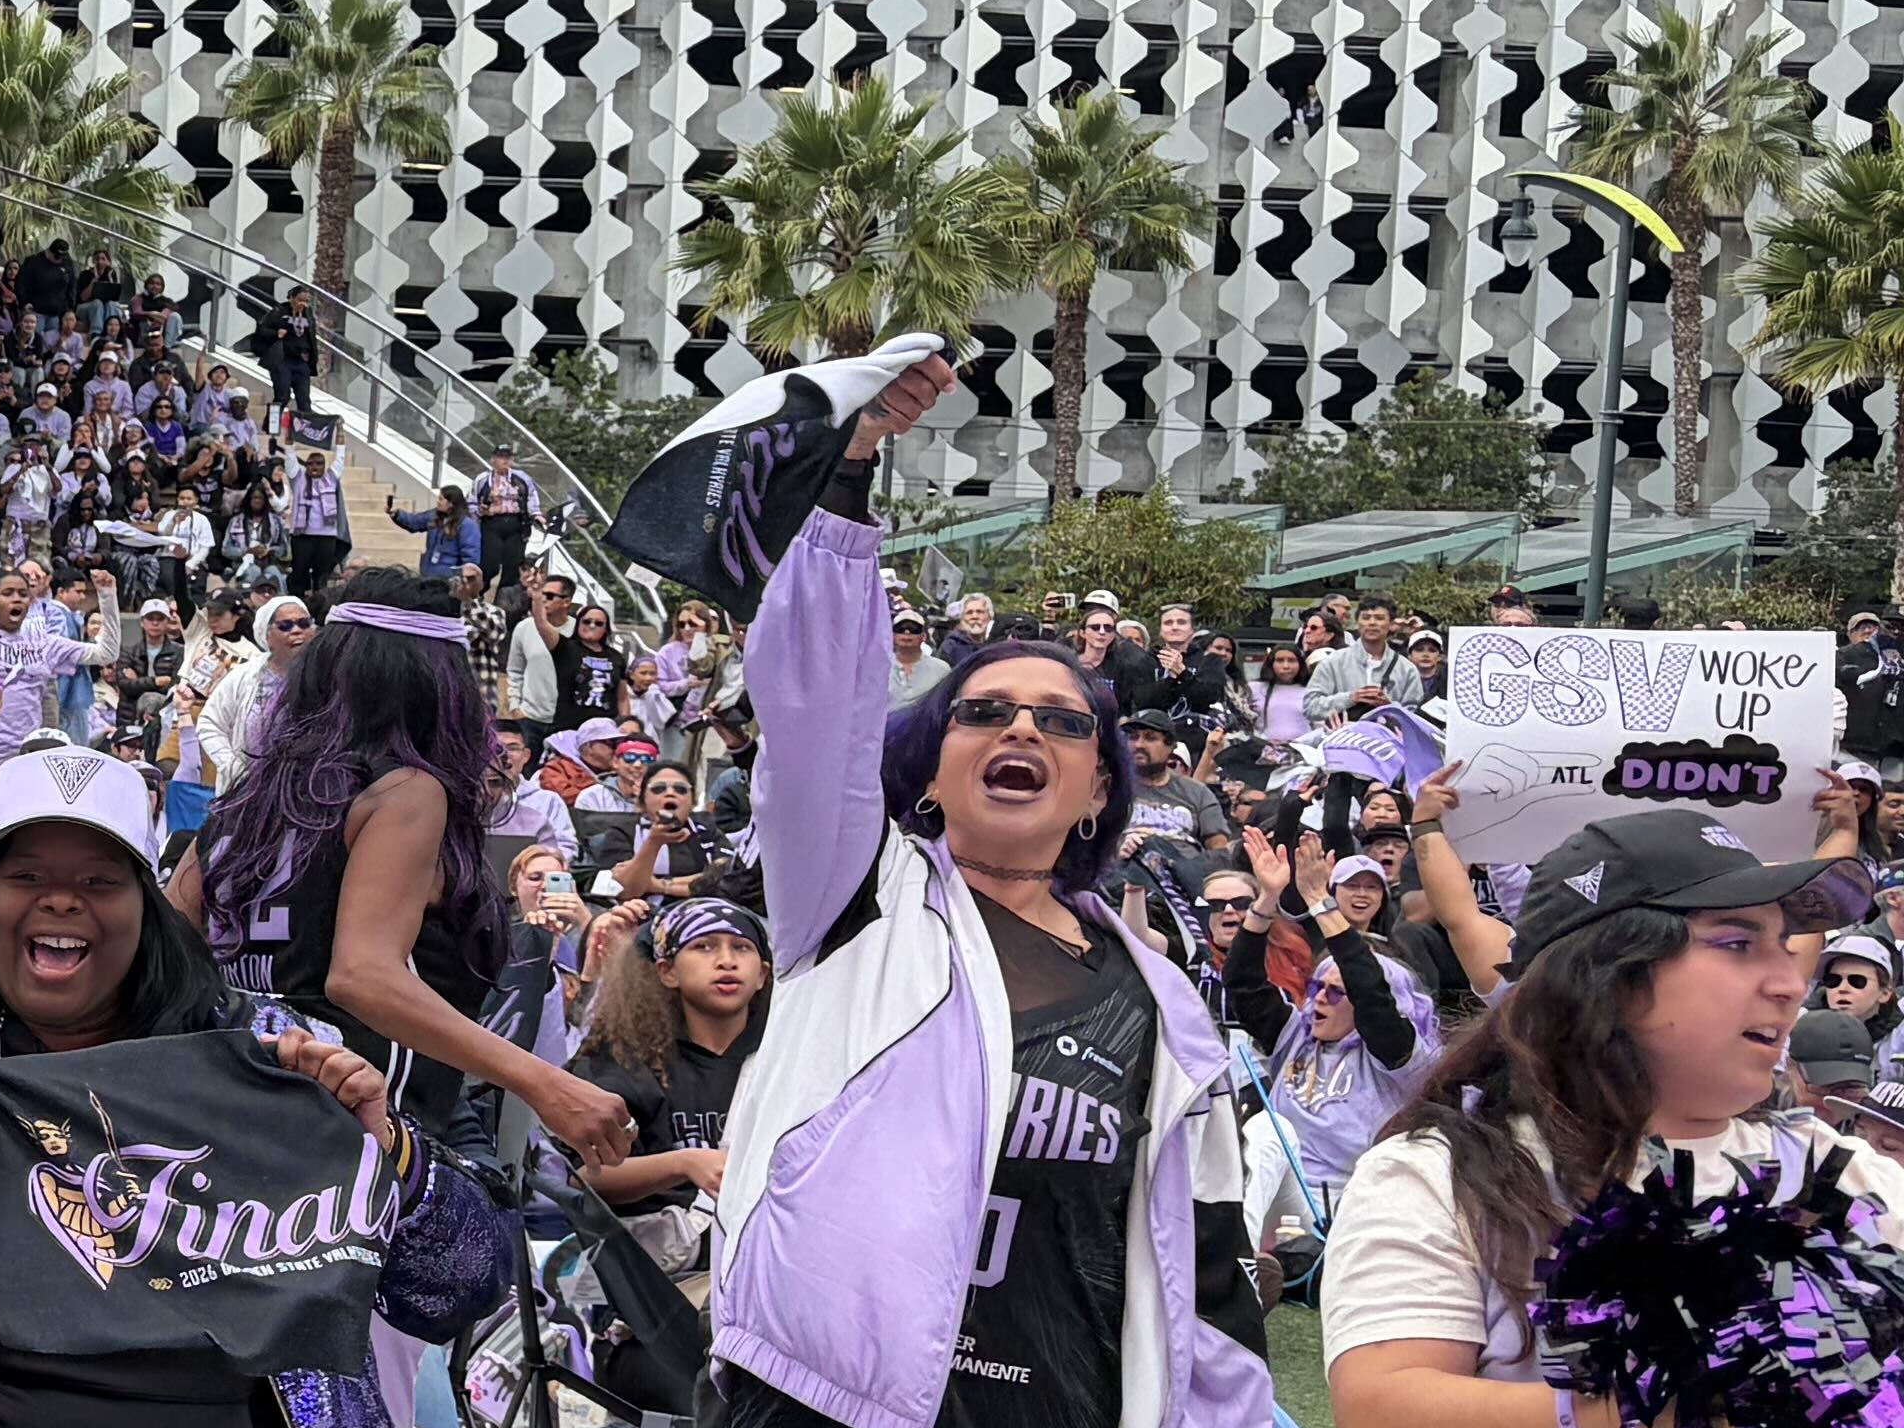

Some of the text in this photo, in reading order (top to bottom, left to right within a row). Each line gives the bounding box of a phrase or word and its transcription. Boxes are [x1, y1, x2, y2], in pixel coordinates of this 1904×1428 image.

[705, 448, 734, 508] VALKYRIES
[1454, 632, 1698, 733] GSV
[1715, 691, 1772, 733] UP
[1552, 757, 1779, 795] ATL DIDN'T
[82, 1131, 400, 1266] Finals
[179, 1264, 219, 1290] 2026
[275, 1254, 324, 1274] STATE
